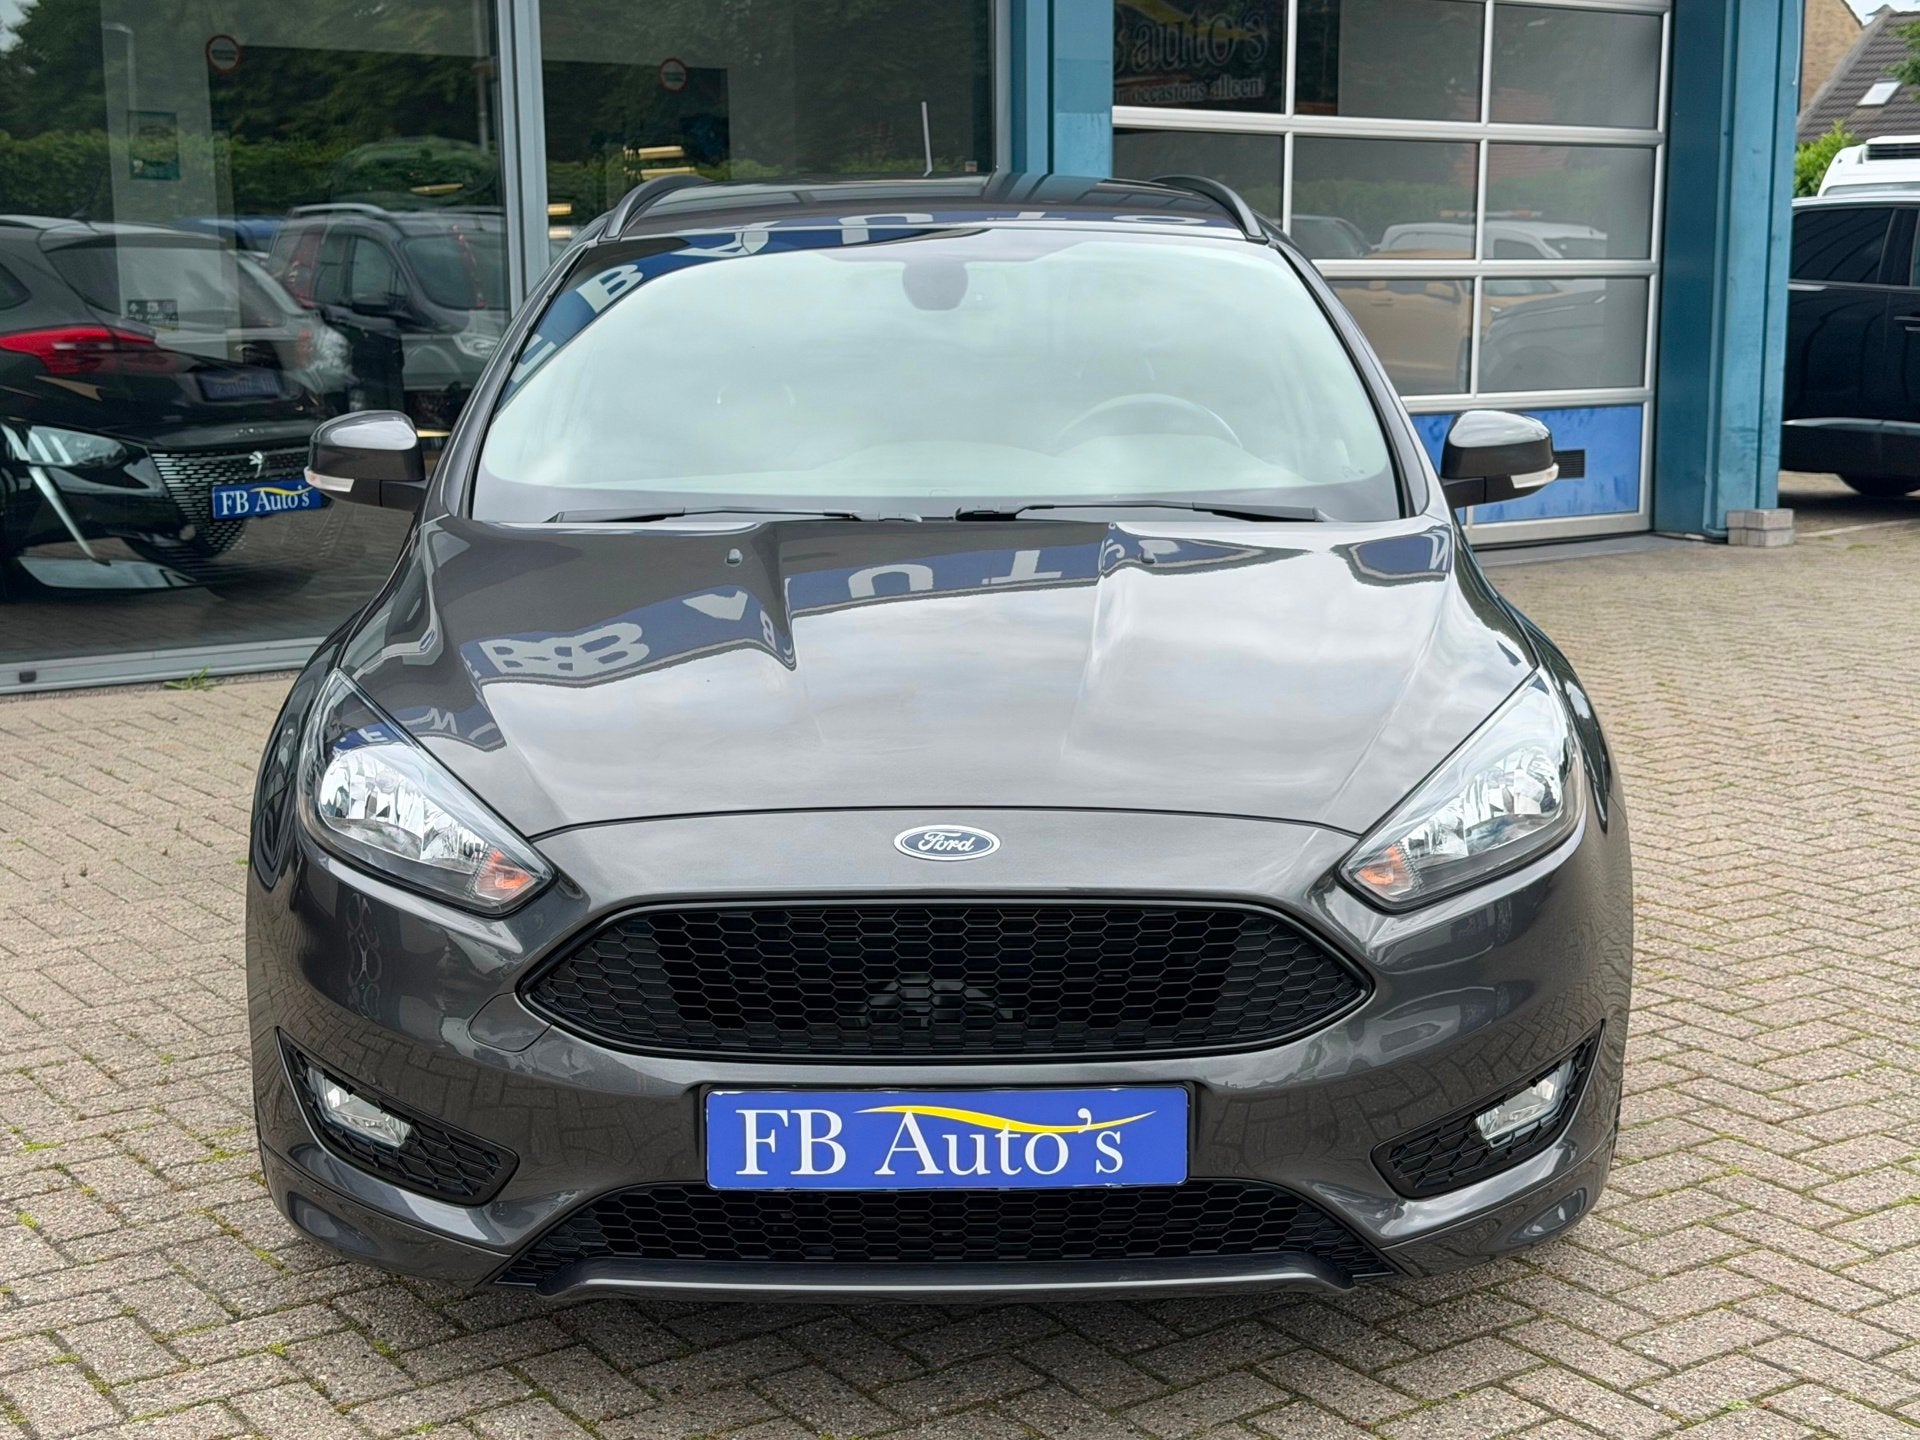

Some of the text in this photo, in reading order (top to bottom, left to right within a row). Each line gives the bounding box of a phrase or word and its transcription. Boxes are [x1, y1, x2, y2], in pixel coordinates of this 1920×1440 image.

[220, 485, 310, 515] FB Auto's
[918, 831, 975, 851] Ford
[735, 1108, 1124, 1175] FB Auto's
